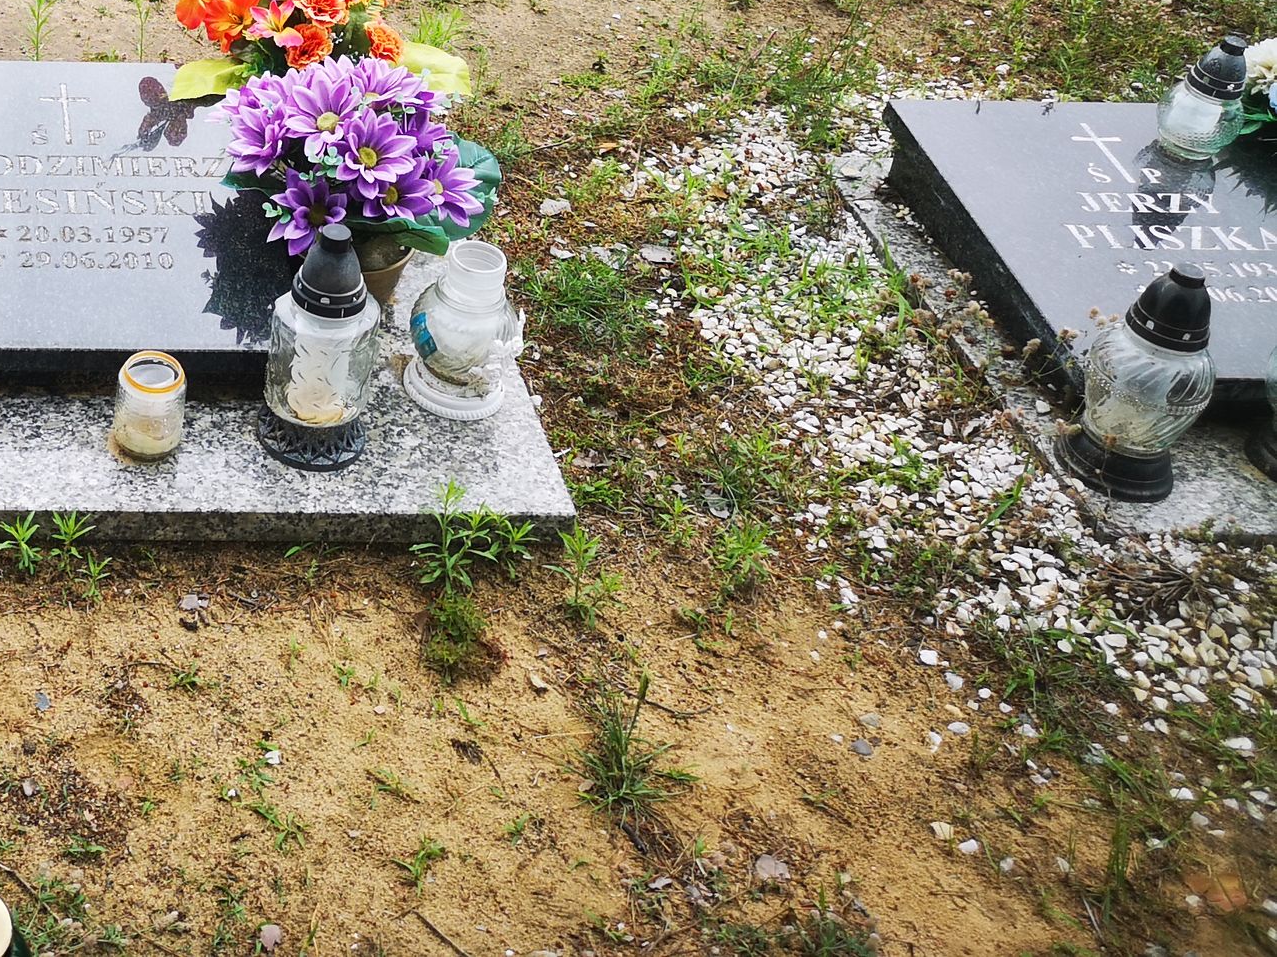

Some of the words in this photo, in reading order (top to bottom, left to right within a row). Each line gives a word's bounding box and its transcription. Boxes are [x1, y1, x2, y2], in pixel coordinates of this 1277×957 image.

[87, 128, 108, 146] P
[1141, 167, 1163, 184] P
[1076, 191, 1221, 214] JERZY
[17, 226, 170, 244] 20.03.1957
[1064, 223, 1277, 251] PLISZKA
[17, 251, 175, 270] 29.06.2010
